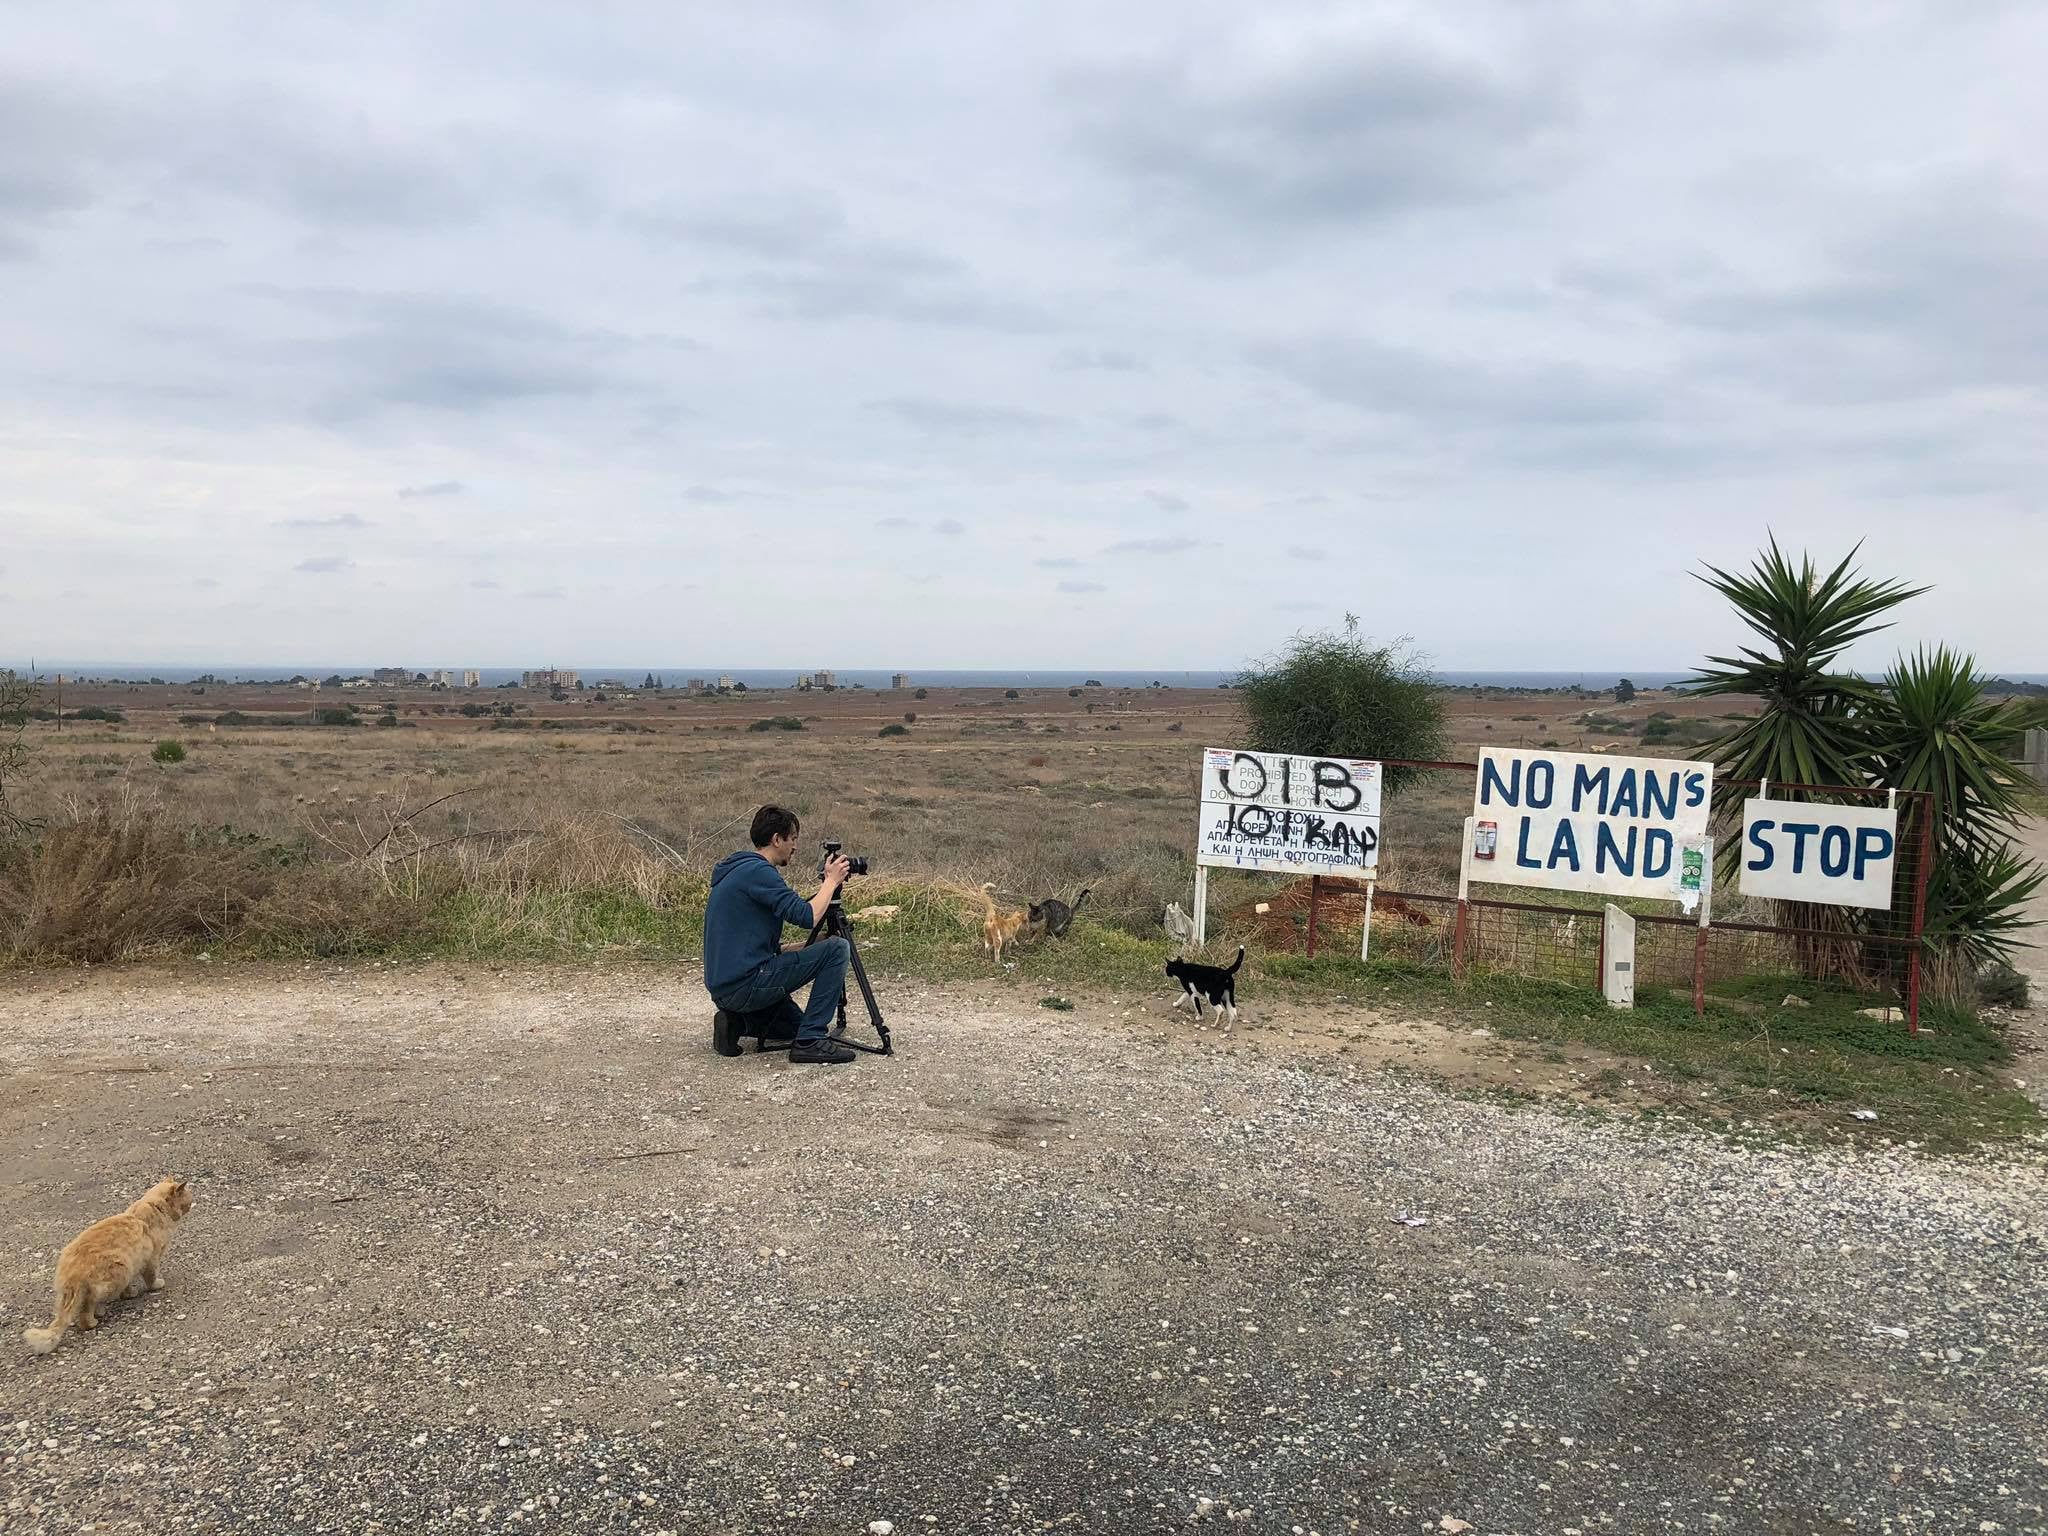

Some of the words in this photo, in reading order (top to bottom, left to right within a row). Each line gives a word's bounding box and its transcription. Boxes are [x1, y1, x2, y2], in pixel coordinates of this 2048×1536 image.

[1480, 757, 1554, 809] NO
[1212, 843, 1231, 854] ΚΑΙ
[1235, 846, 1243, 855] Η
[1247, 847, 1279, 859] ΛΗΨΗ
[1284, 850, 1362, 866] ΦΩΤΟΓΡΑΦΙΩΝ
[1290, 839, 1298, 849] Η
[1516, 816, 1673, 878] LAND
[1748, 820, 1893, 880] STOP
